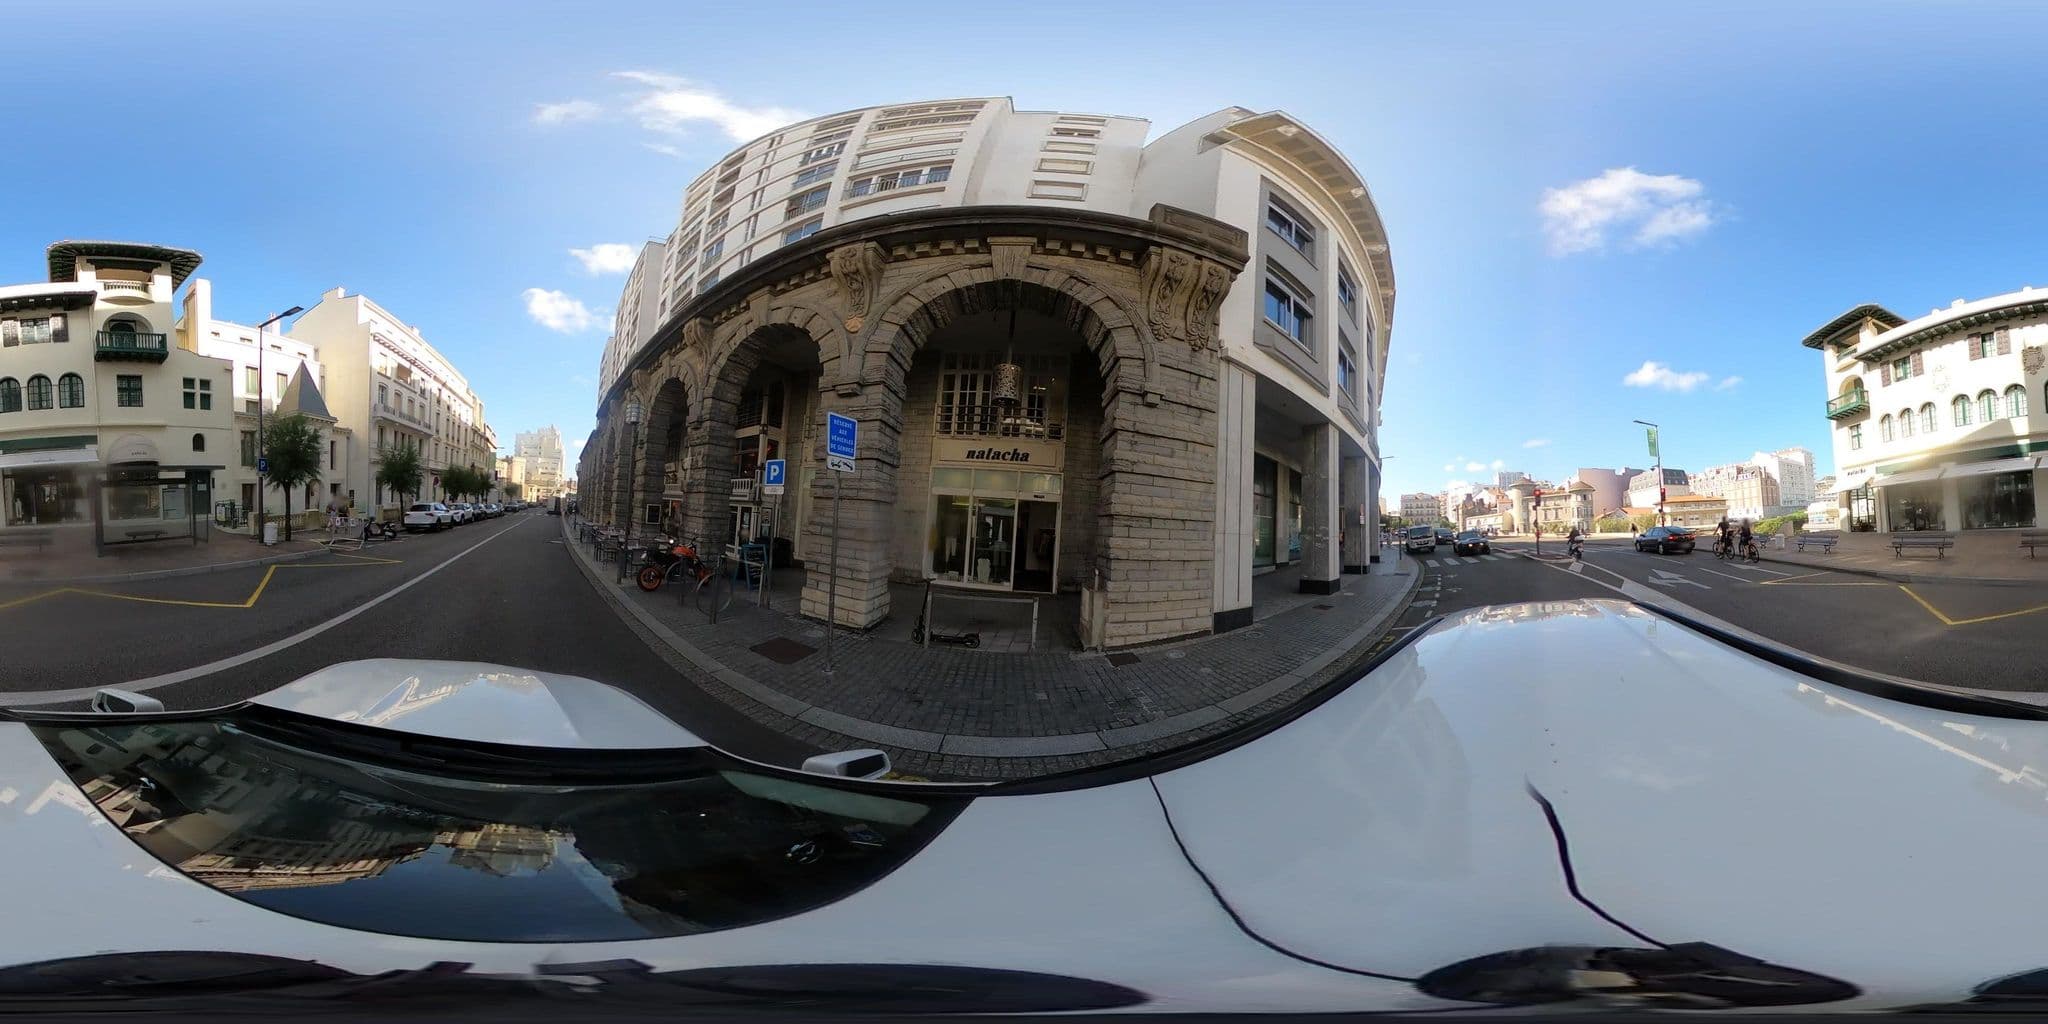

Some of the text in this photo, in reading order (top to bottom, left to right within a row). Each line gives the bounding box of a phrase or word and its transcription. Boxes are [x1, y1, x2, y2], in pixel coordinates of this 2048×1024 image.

[966, 448, 1030, 461] natacha
[260, 460, 266, 470] P
[770, 465, 780, 480] P
